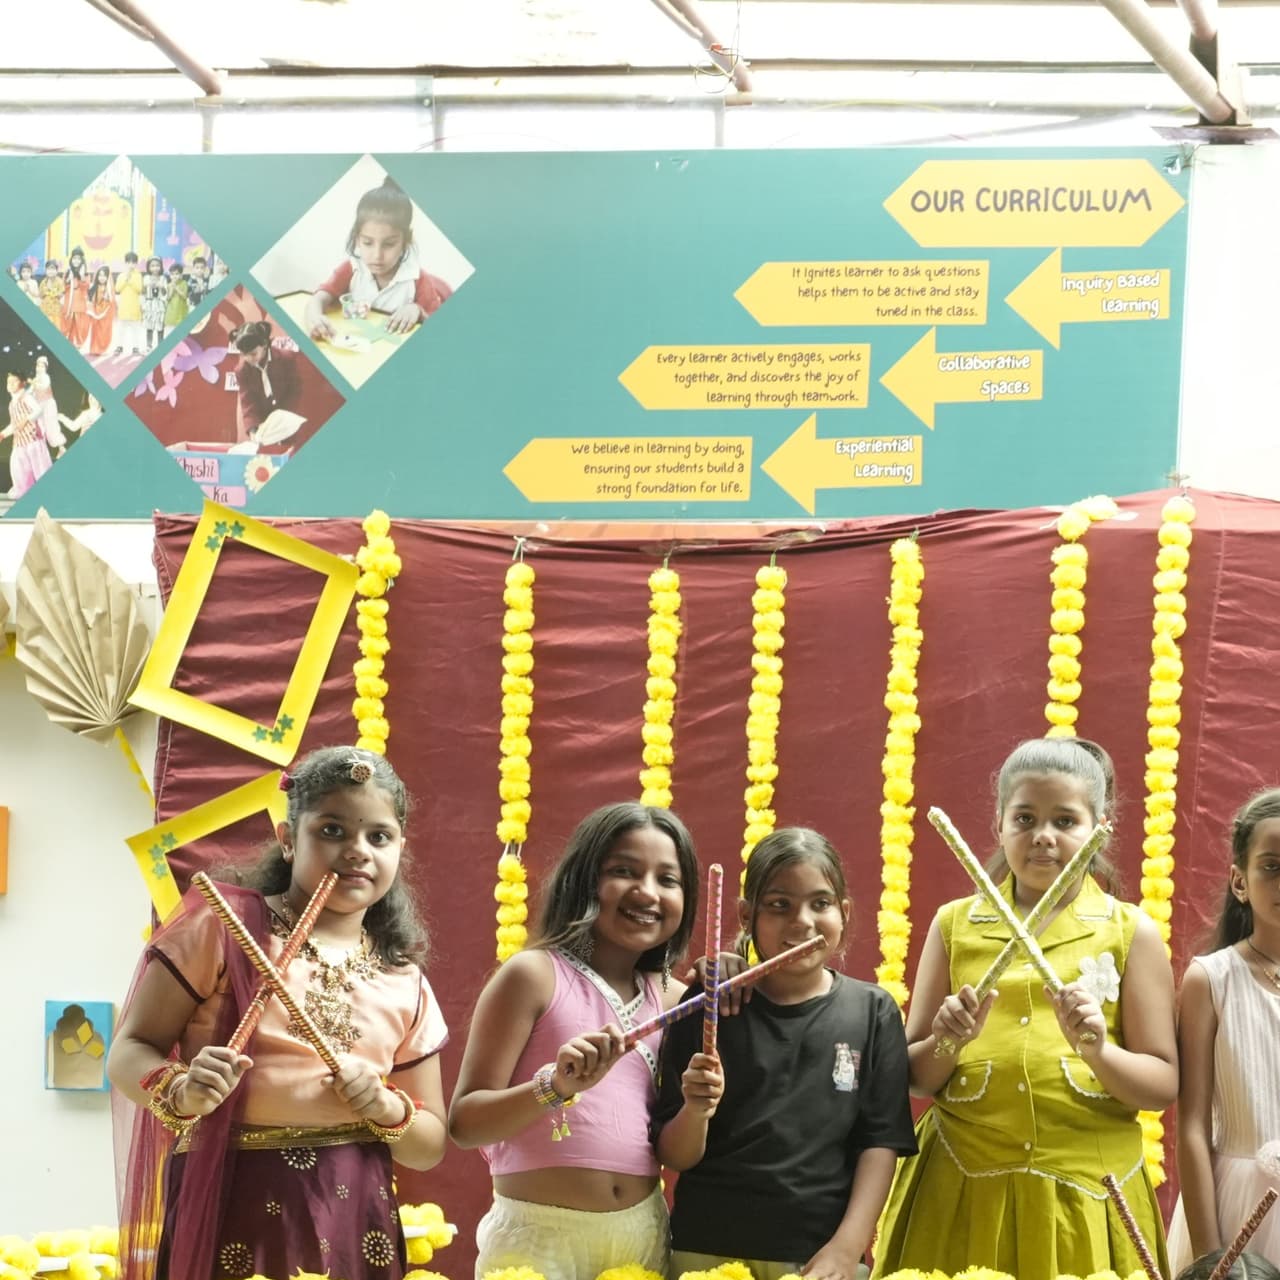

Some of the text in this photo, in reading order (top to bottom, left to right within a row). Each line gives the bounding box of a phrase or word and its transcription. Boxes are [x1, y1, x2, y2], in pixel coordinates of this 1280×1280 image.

[910, 187, 1152, 213] OUR CURRICULUM
[792, 266, 981, 283] It Ignites learner to ask questions
[1061, 271, 1160, 295] Inquiry Based
[798, 285, 980, 301] helps them to be active and stay
[876, 305, 978, 317] tuned in the class.
[657, 351, 861, 367] Every learner actively engages, works
[938, 355, 1031, 372] Collaborative
[674, 370, 861, 388] together, and discovers the joy of
[980, 379, 1030, 400] Spaces
[707, 391, 859, 408] learning through teamwork.
[571, 442, 745, 458] We believe in learning by doing,
[835, 437, 915, 459] Experiential
[584, 462, 745, 479] ensuring our students build a
[596, 481, 743, 499] strong foundation for life.
